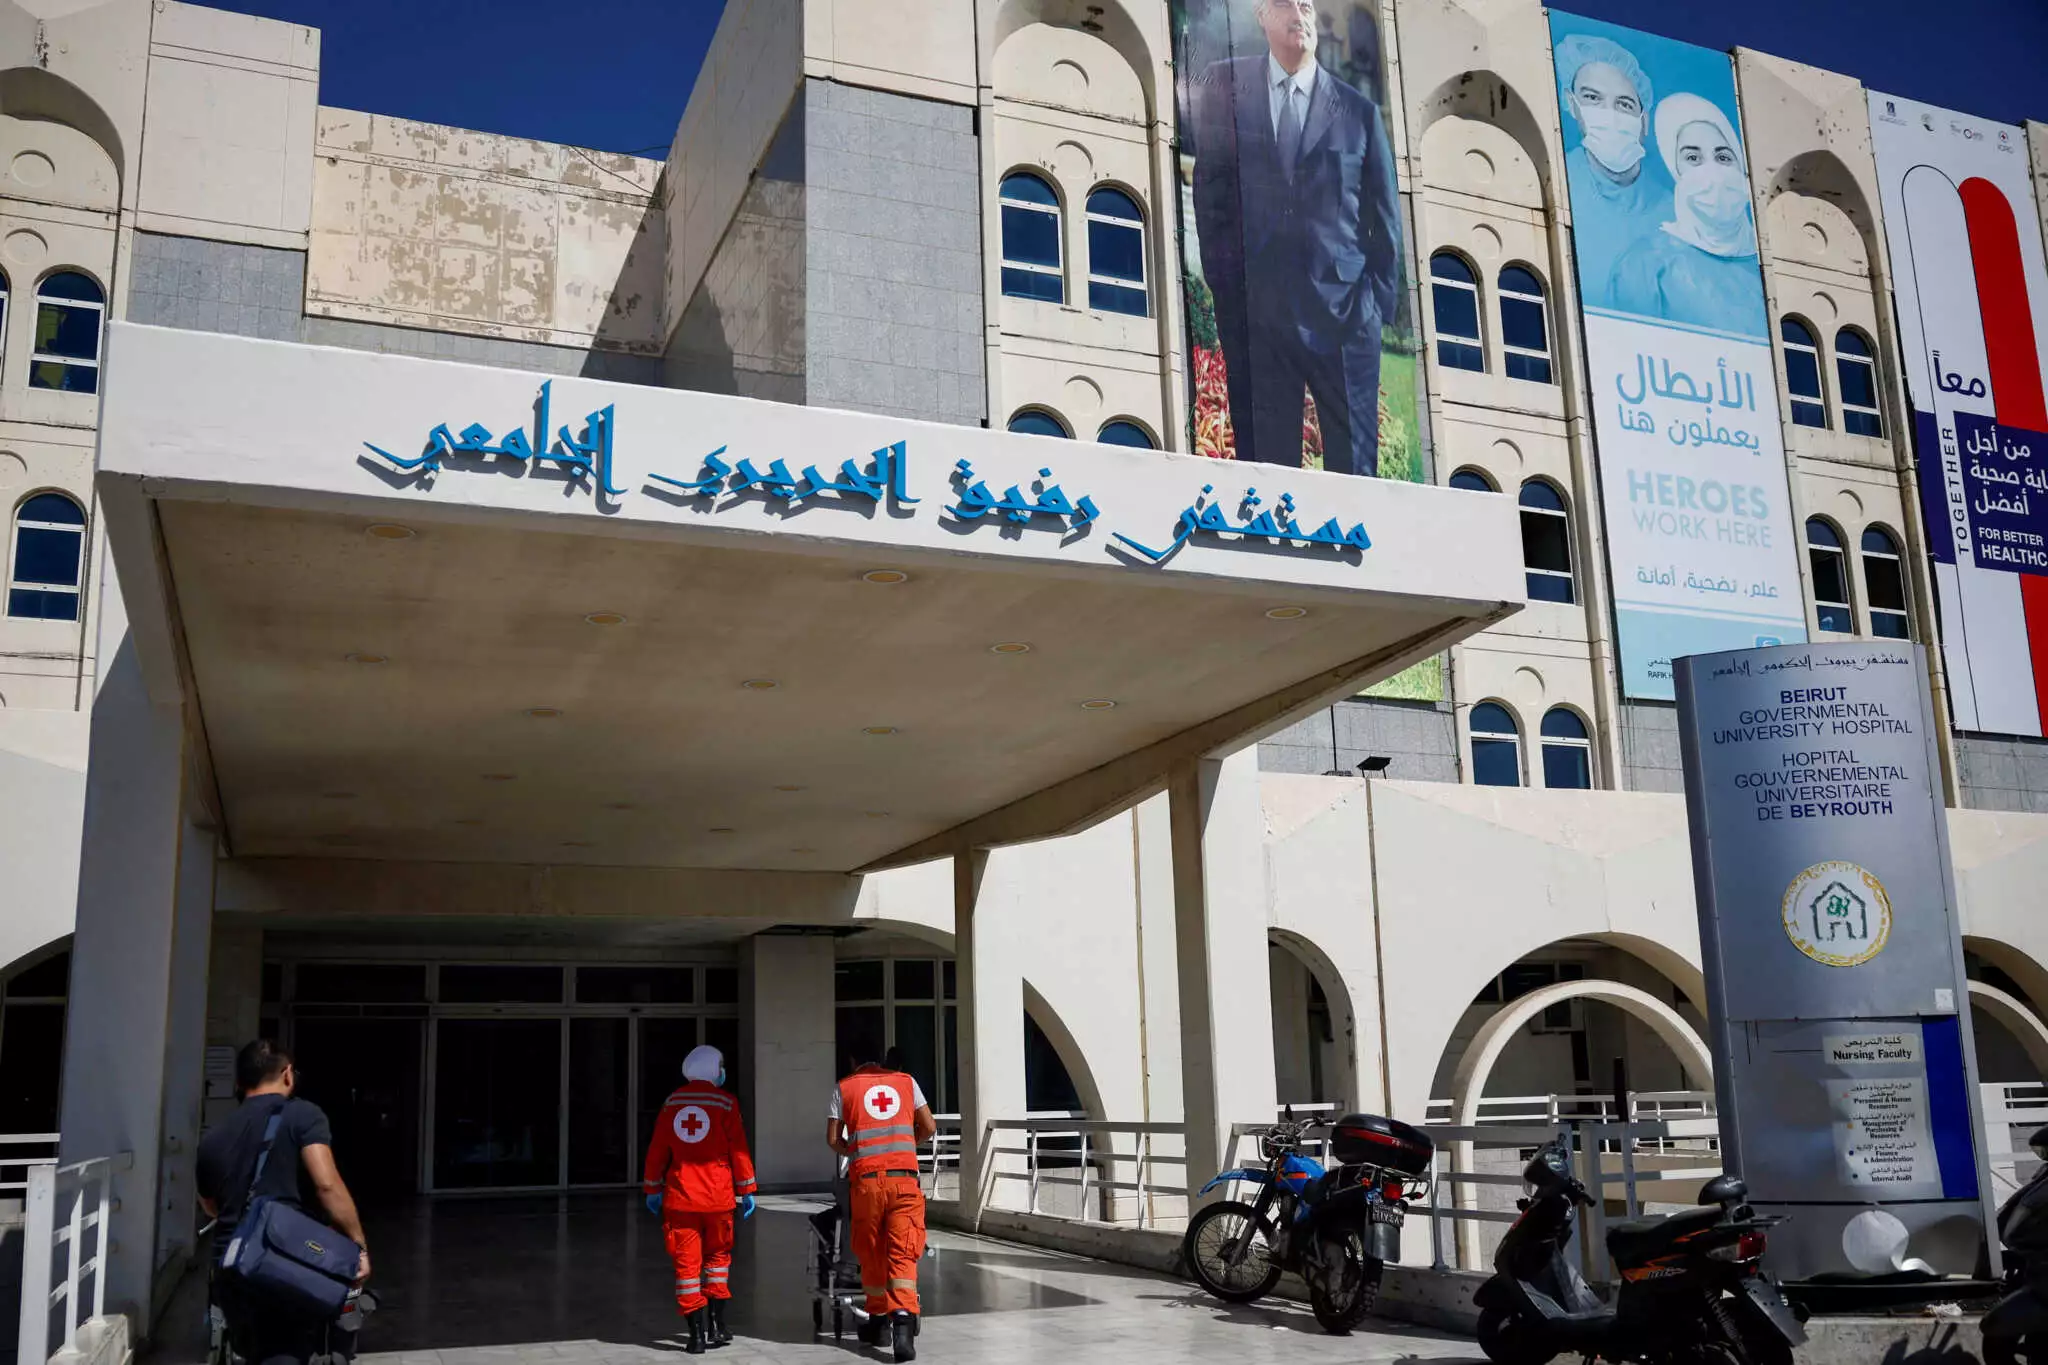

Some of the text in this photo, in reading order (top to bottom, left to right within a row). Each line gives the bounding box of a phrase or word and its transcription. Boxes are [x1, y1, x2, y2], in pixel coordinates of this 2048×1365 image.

[1616, 353, 1755, 411] الأبطال
[363, 379, 628, 494] الجامعي
[1618, 404, 1760, 456] يعملون هنا
[1966, 425, 2030, 460] من أجل
[648, 440, 922, 502] الحريري
[1970, 459, 2048, 494] اية صحية
[943, 458, 1101, 529] رفيق
[1627, 469, 1768, 520] HEROES
[1942, 428, 1970, 555] TOGETHER
[1975, 488, 2029, 515] أفضل
[1632, 507, 1772, 548] WORK HERE
[1978, 527, 2044, 546] FOR BETTER
[1981, 544, 2048, 566] HEALTHC
[1637, 565, 1676, 586] أمانة
[1780, 687, 1847, 704] BEIRUT
[1739, 703, 1889, 725] GOVERNMENTAL
[1713, 719, 1912, 744] UNIVERSITY HOSPITAL
[1782, 750, 1859, 767] HOPITAL
[1735, 766, 1908, 789] GOUVERNEMENTAL
[1756, 783, 1892, 804] UNIVERSITAIRE
[1758, 801, 1893, 821] DE BEYROUTH
[1833, 1048, 1912, 1061] Nursing Faculty
